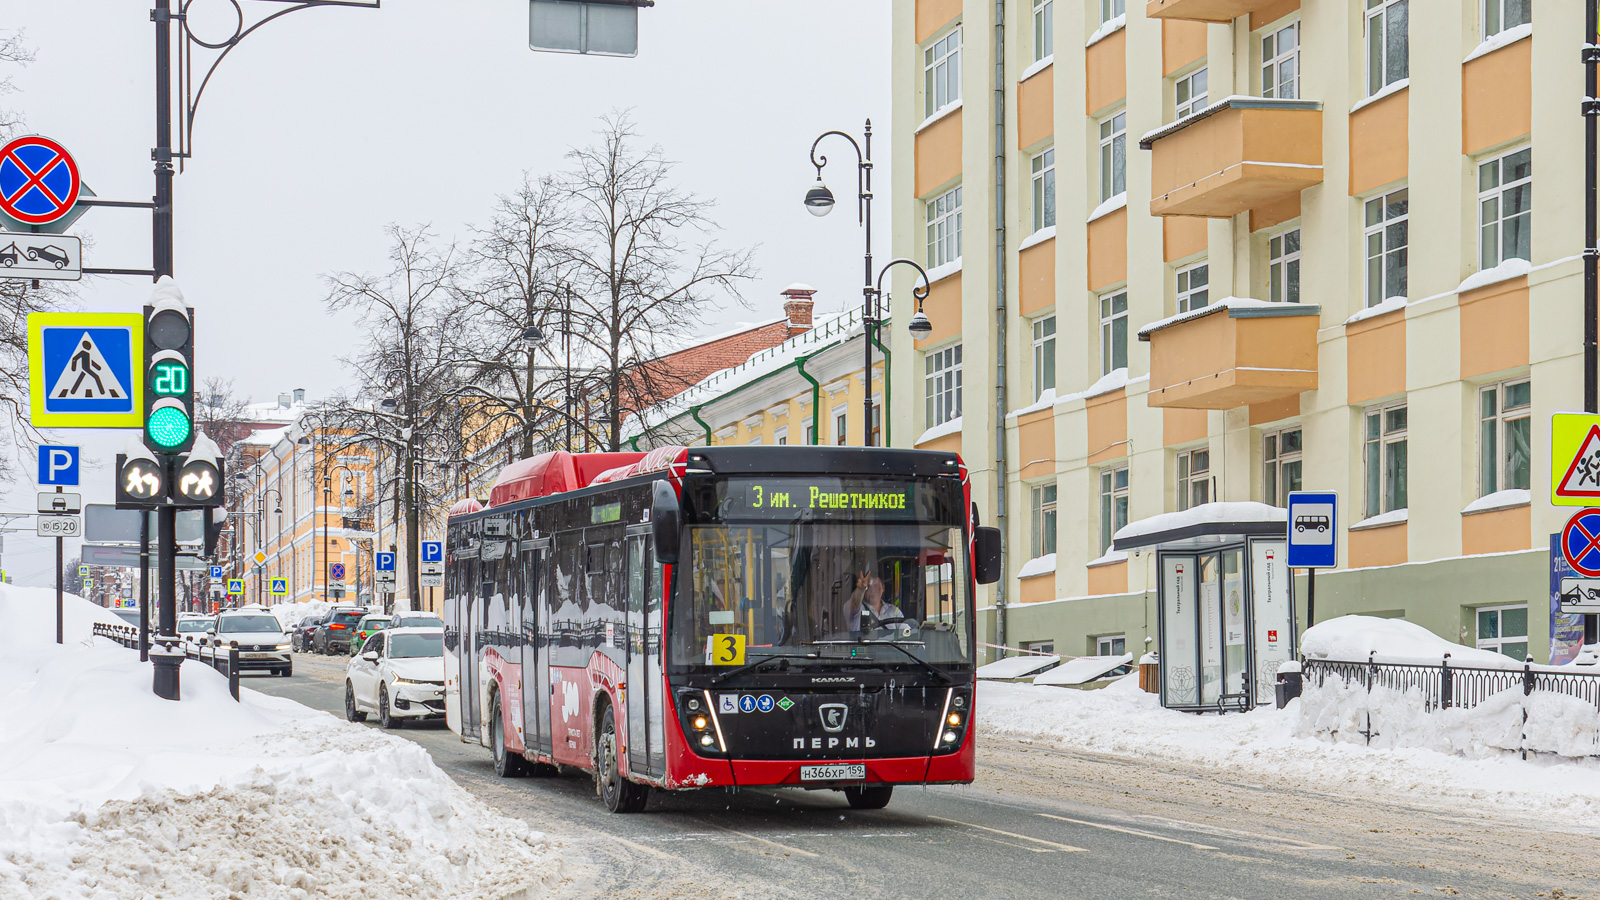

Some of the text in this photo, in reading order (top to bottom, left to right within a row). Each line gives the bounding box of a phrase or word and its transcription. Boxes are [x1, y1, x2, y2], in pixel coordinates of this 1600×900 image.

[156, 366, 186, 394] 20
[49, 449, 73, 481] P
[752, 485, 763, 508] 3
[770, 492, 797, 508] им.
[52, 522, 60, 530] 15
[63, 522, 75, 531] 20
[427, 544, 439, 560] P
[381, 554, 392, 569] P
[213, 567, 220, 576] P
[720, 636, 737, 662] 3
[793, 736, 876, 749] ПЕРМЬ
[847, 765, 862, 775] 159
